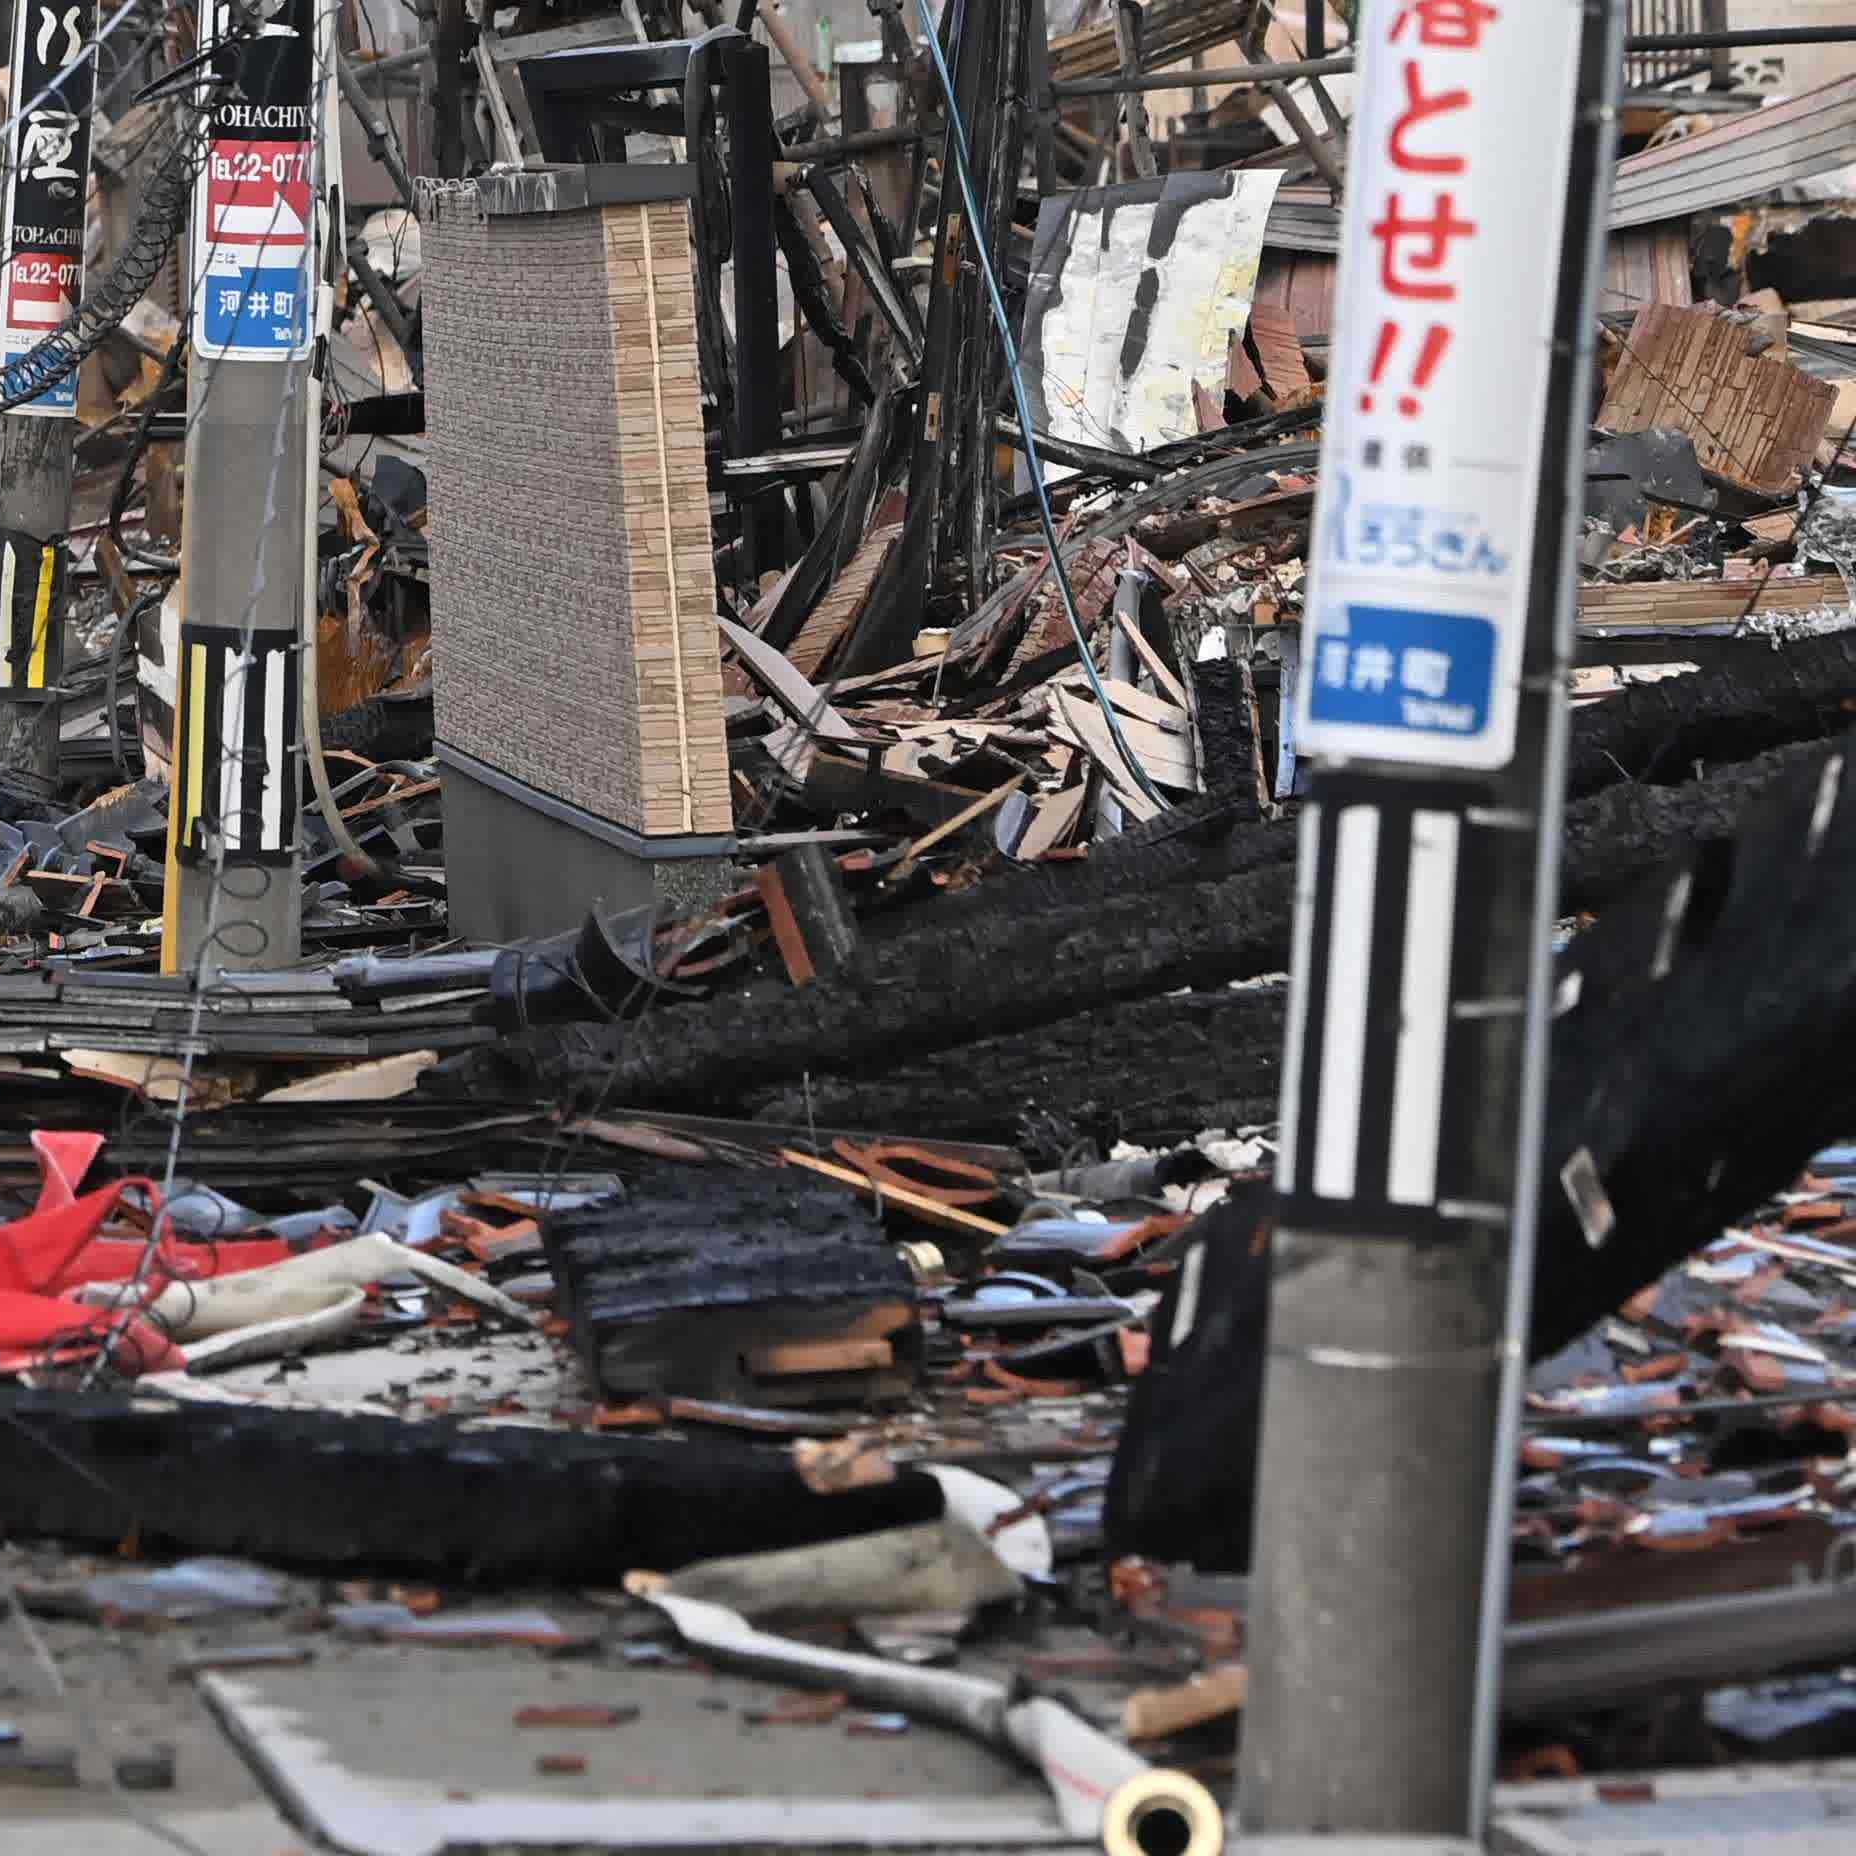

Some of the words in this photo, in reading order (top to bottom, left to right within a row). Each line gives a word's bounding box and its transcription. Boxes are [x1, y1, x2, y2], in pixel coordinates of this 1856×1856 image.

[214, 104, 312, 128] OHACHIY
[219, 291, 294, 319] 河井町
